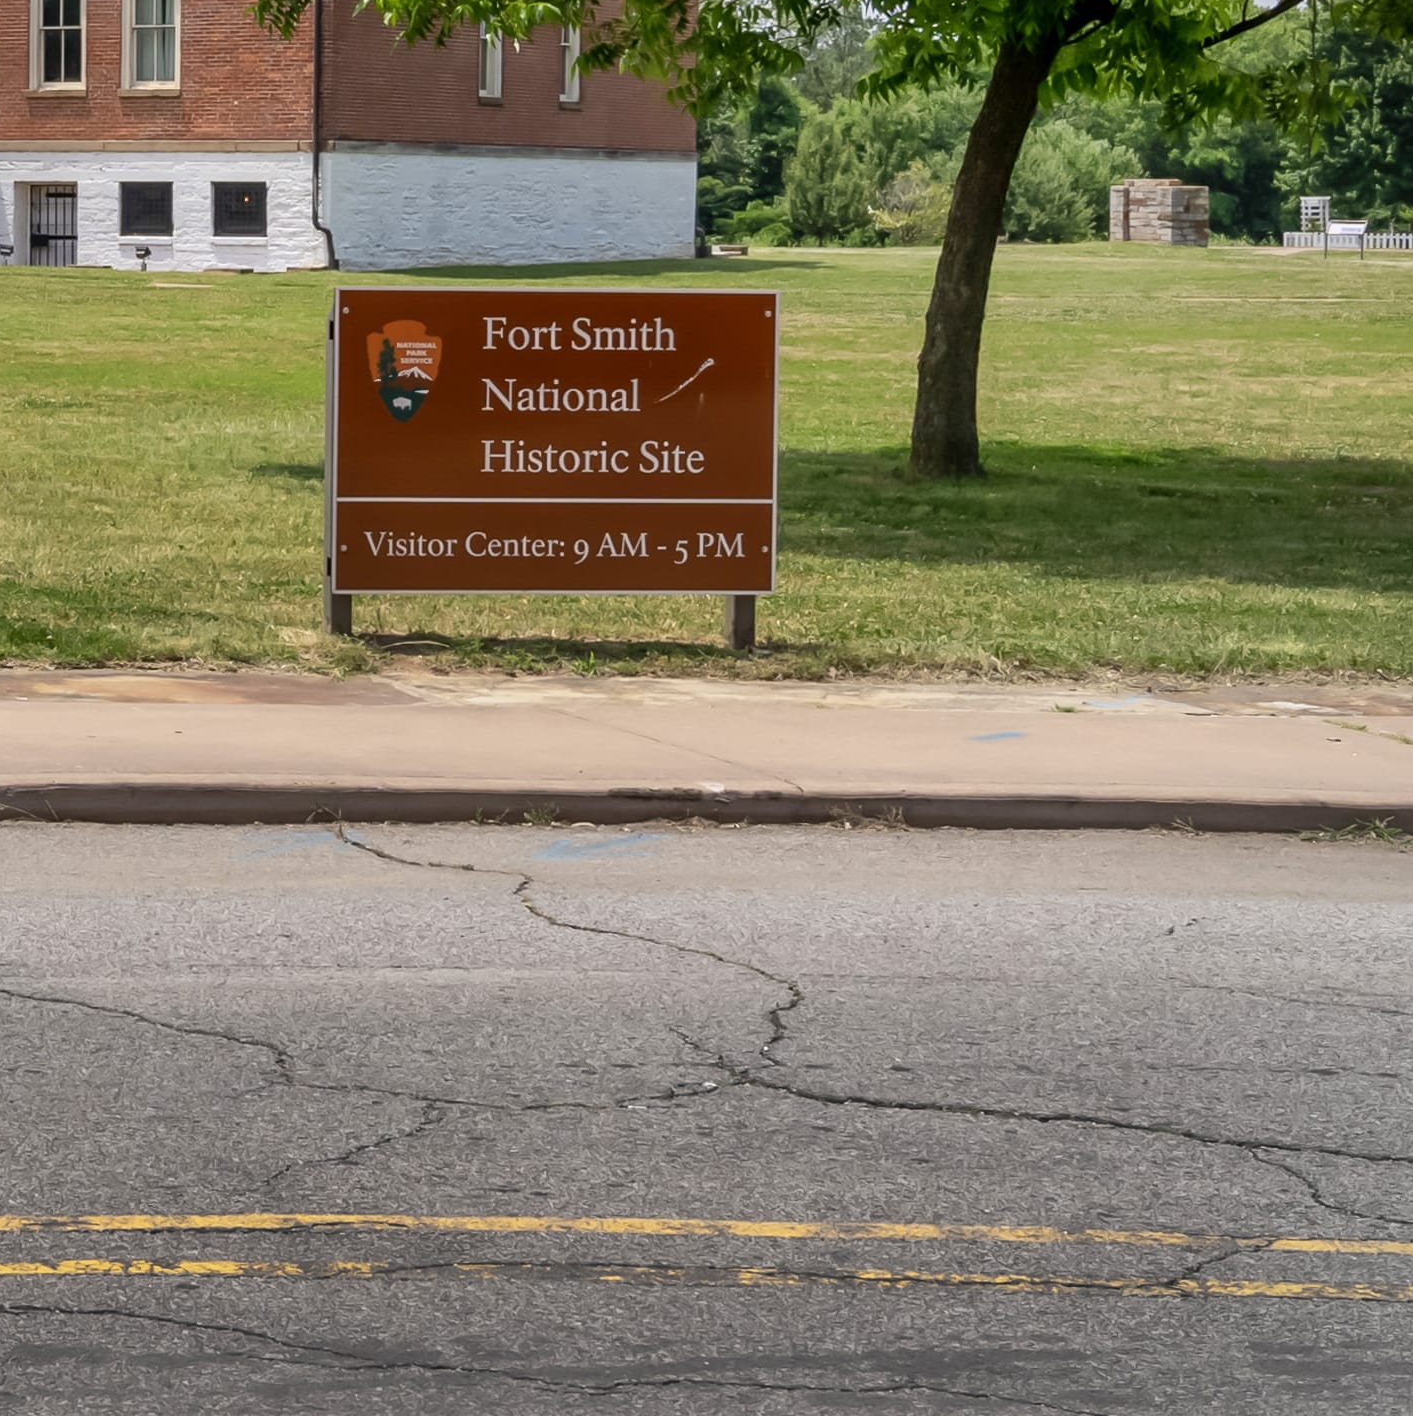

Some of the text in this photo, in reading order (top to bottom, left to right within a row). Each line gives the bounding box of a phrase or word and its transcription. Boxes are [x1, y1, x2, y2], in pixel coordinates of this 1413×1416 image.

[482, 316, 677, 352] Fort Smith
[400, 357, 433, 365] SERVICE
[405, 349, 427, 357] PARK
[481, 378, 641, 412] National
[480, 439, 705, 474] Historic Site
[363, 531, 458, 557] Visitor
[464, 531, 565, 557] Center:
[573, 539, 590, 565] 9
[596, 532, 650, 558] AM
[673, 539, 689, 565] 5
[696, 532, 746, 558] PM
